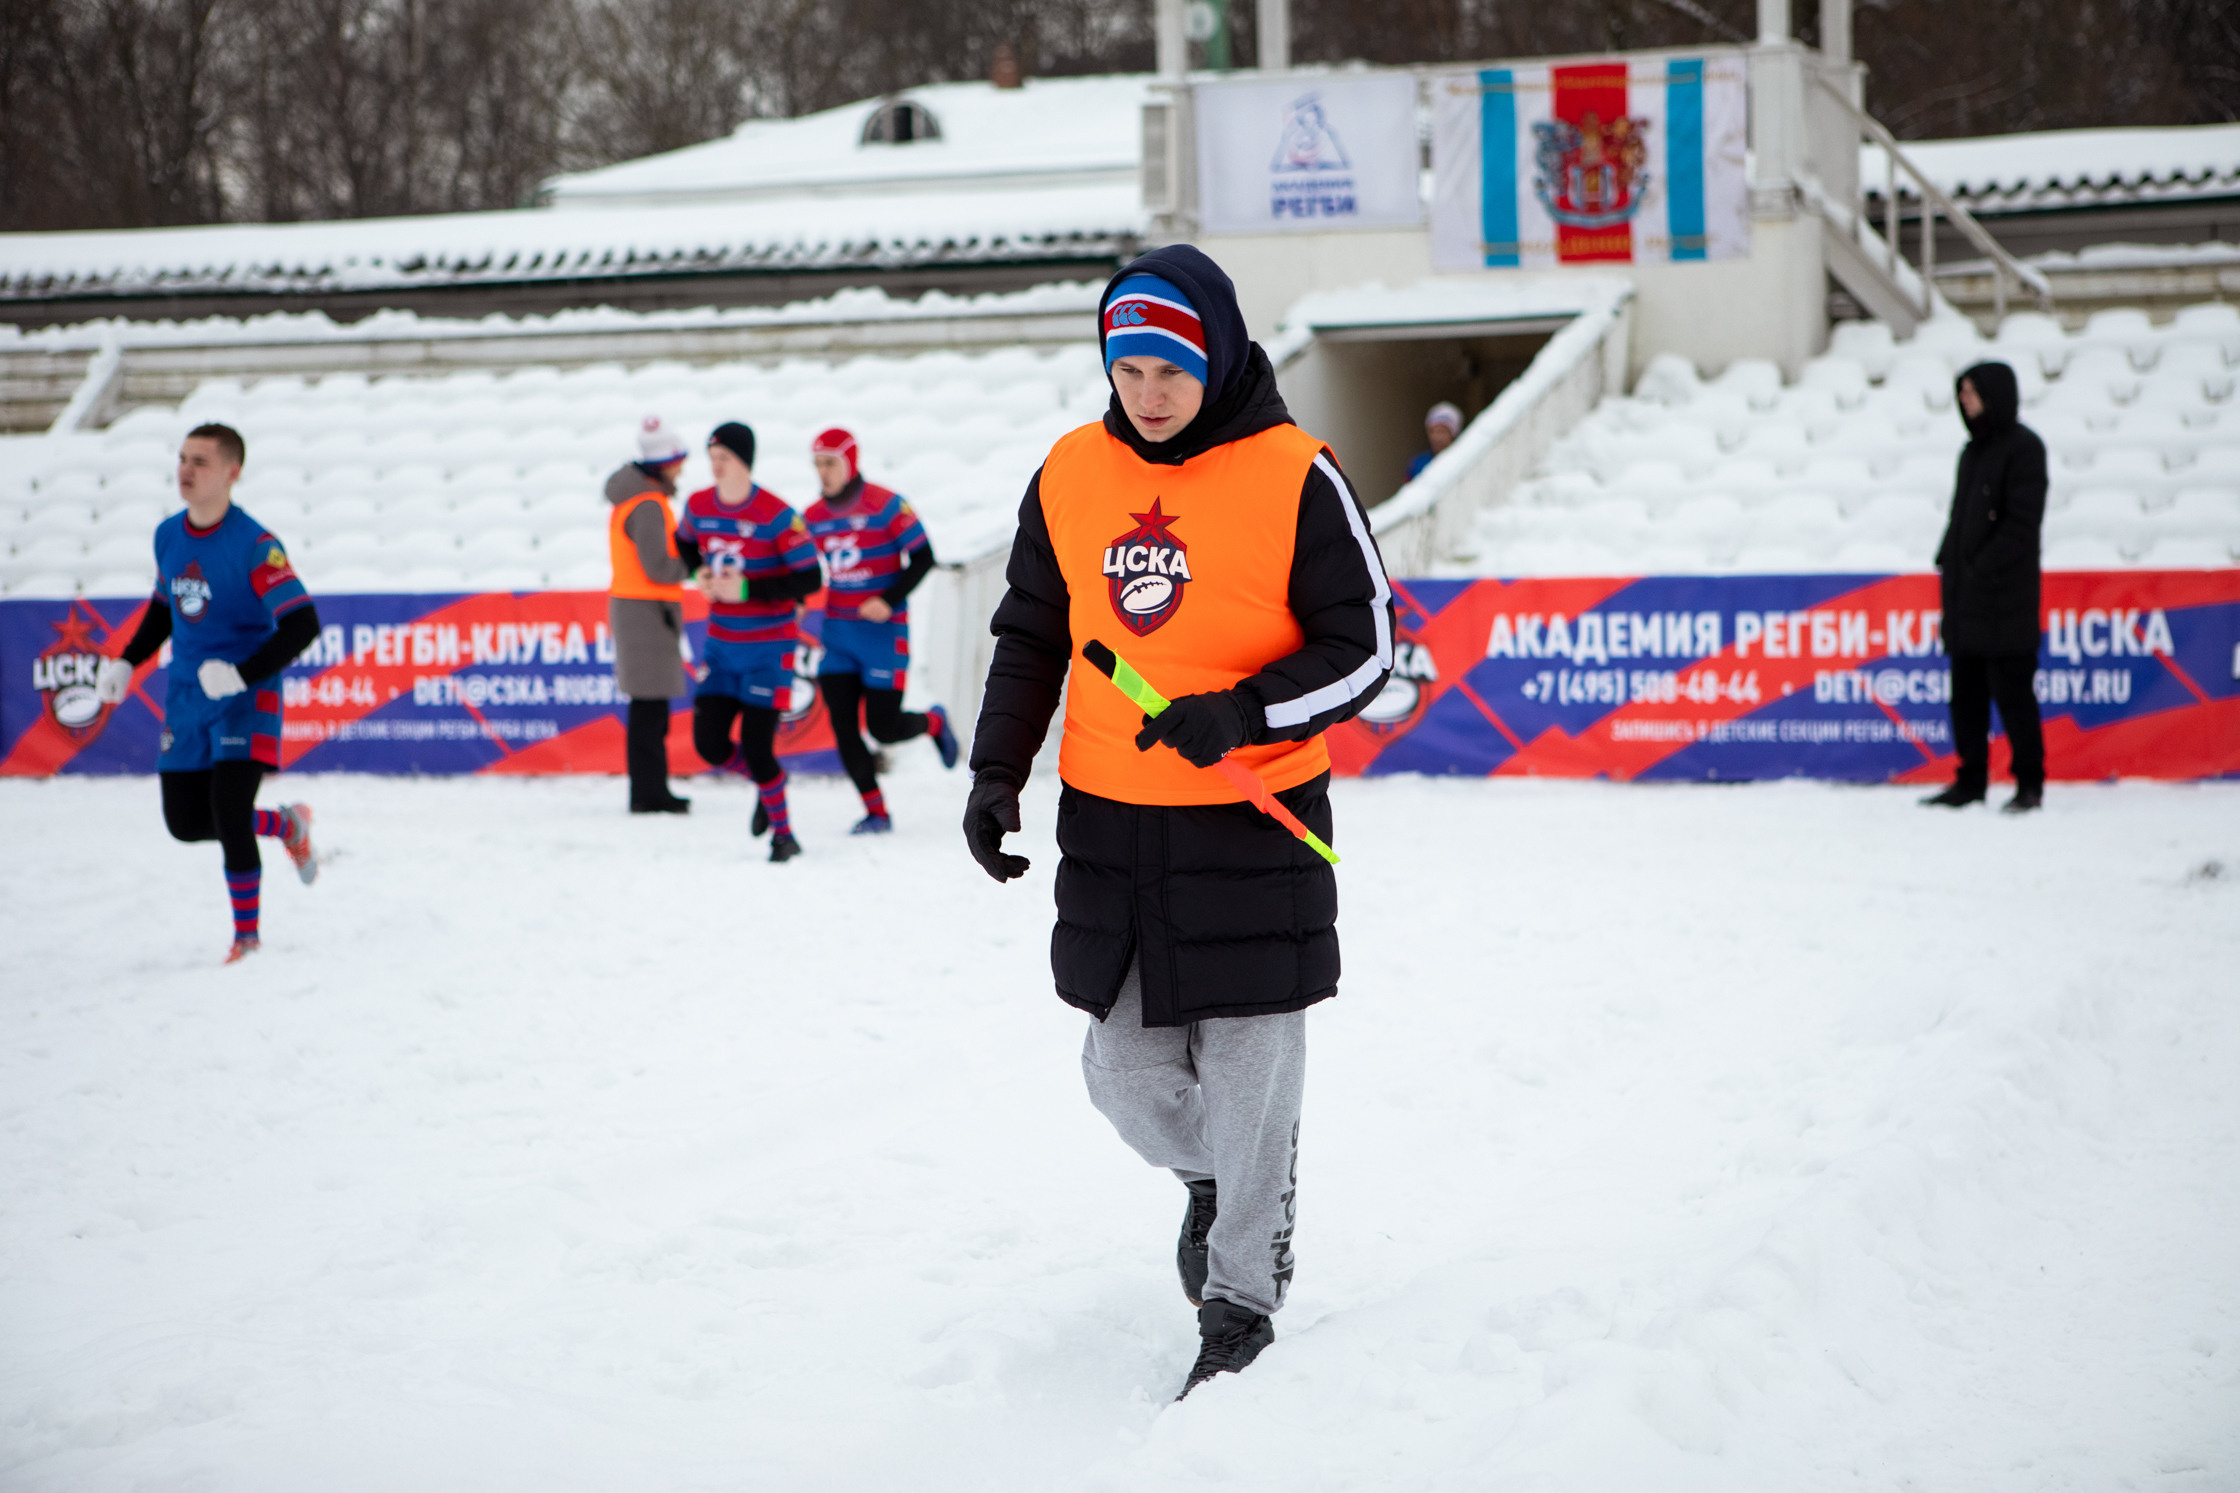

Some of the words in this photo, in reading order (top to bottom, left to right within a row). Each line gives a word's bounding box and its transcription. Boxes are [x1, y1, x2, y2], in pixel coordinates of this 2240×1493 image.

[1102, 545, 1192, 580] ЦСКА
[170, 577, 212, 601] ЦСКА
[352, 621, 590, 667] РЕГБИ-КЛУБА
[1486, 612, 1722, 666] АКАДЕМИЯ
[1735, 610, 1944, 659] РЕГБИ-КЛ
[2048, 609, 2175, 665] ЦСКА
[1392, 642, 1439, 681] КА
[1521, 670, 1555, 703] +7
[1558, 667, 1627, 706] (495)
[1709, 719, 1778, 744] ДЕТСКИЕ
[1779, 719, 1840, 744] СЕКЦИИ
